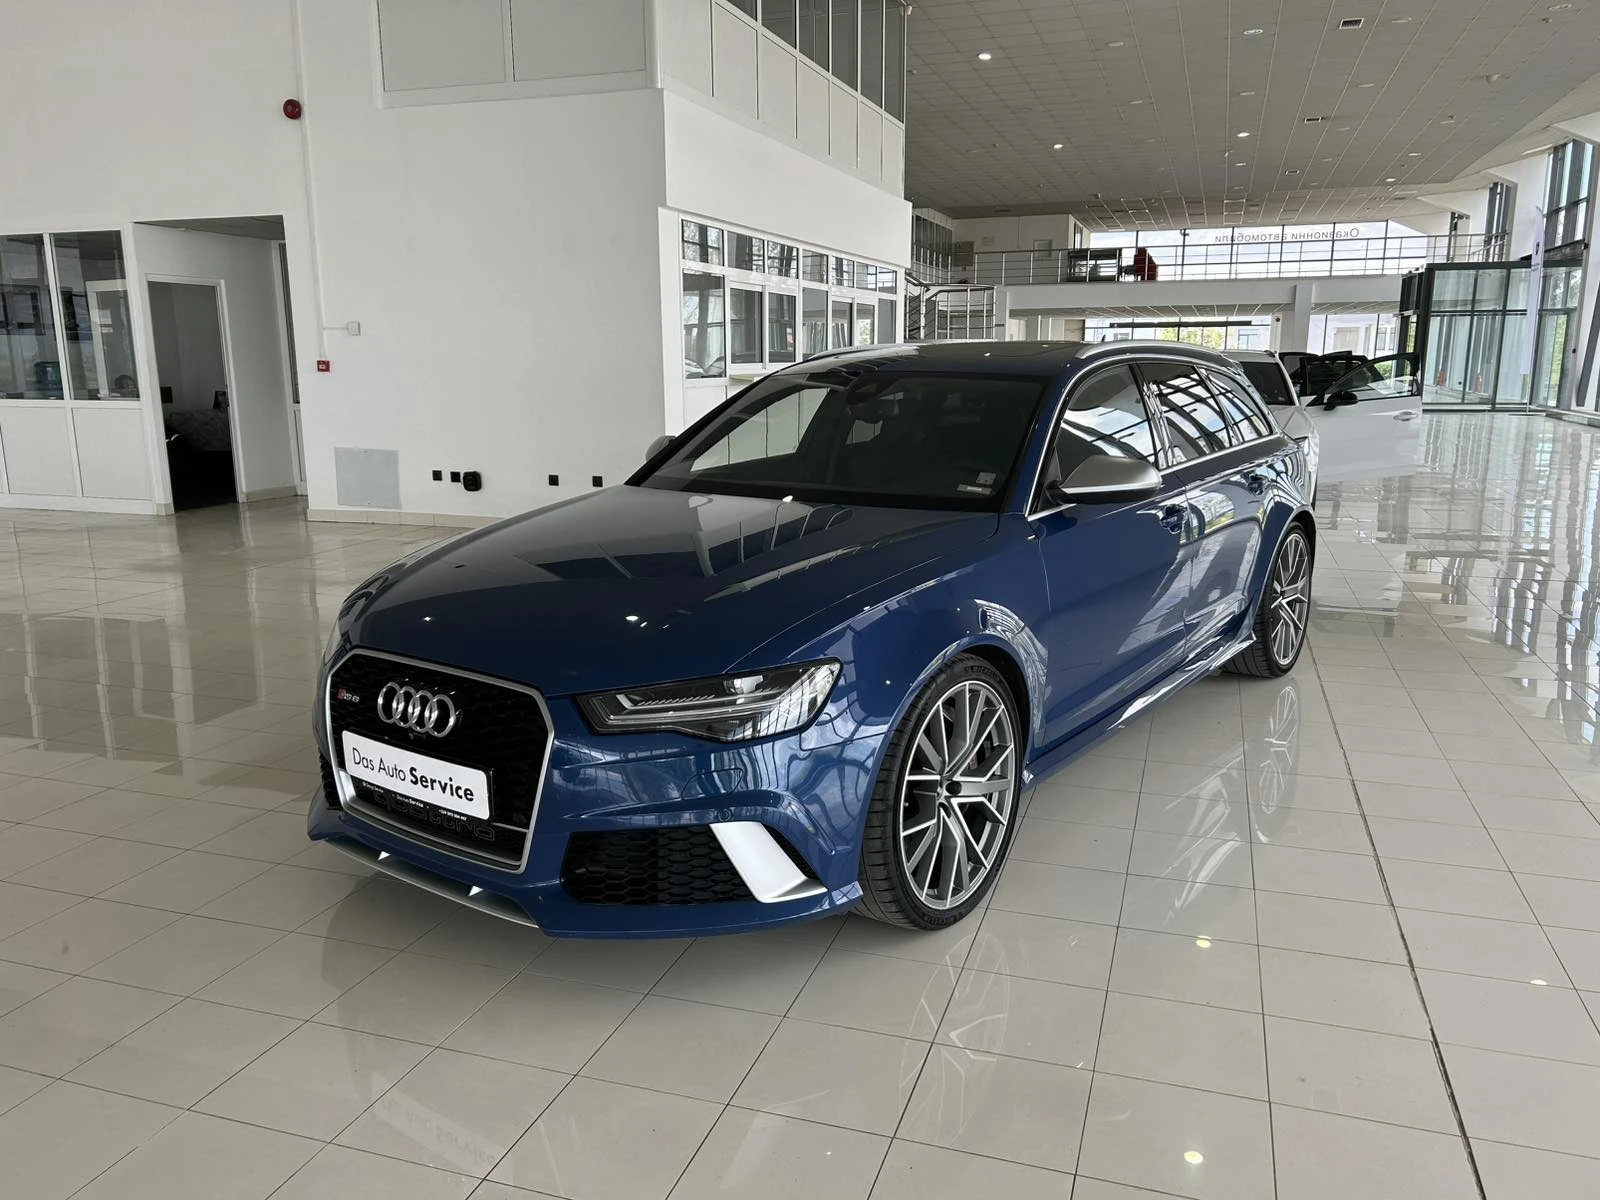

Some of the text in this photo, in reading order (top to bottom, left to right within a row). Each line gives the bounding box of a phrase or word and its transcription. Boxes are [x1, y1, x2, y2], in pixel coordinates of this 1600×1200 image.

[352, 747, 375, 771] Das
[378, 757, 406, 782] Auto
[409, 766, 474, 802] Service
